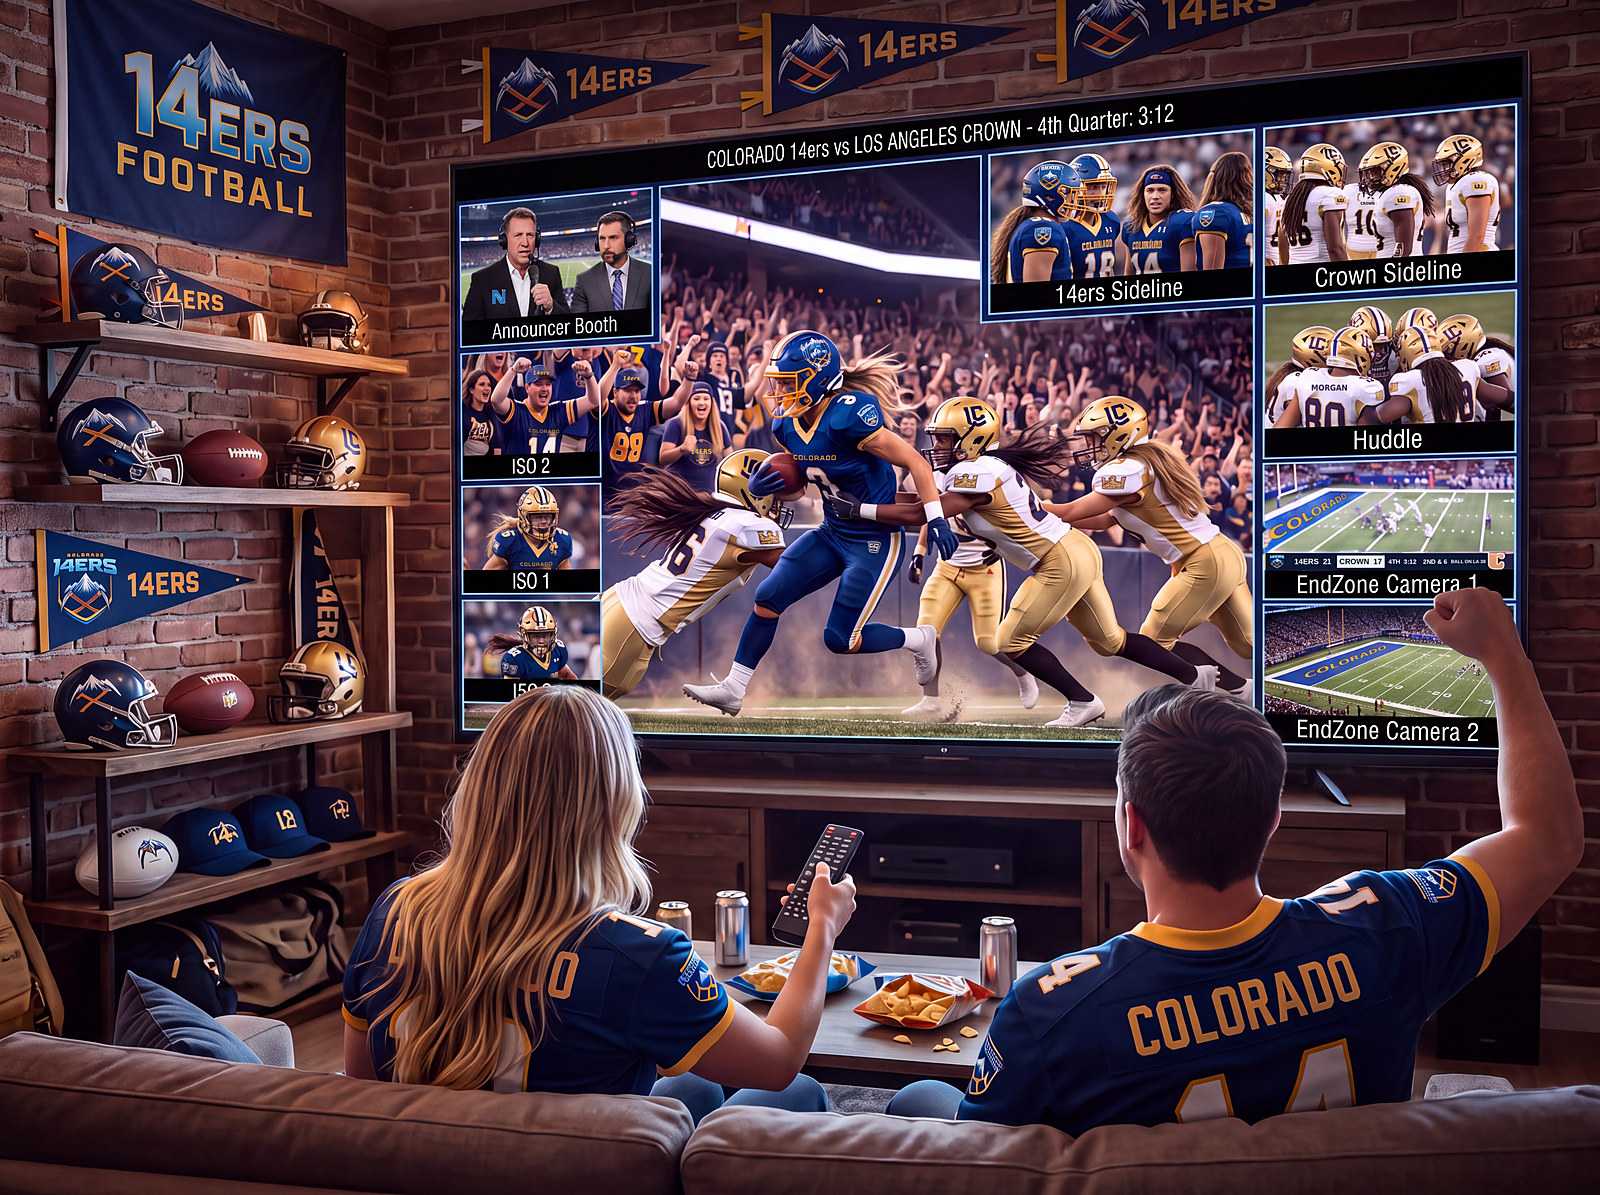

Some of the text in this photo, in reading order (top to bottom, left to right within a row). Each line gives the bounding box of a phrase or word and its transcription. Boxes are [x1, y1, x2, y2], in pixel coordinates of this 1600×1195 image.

[859, 30, 957, 67] 14ERS
[566, 65, 652, 100] 14ERS
[125, 51, 311, 174] 14ERS
[707, 143, 784, 168] COLORADO
[791, 141, 830, 160] 14ers
[834, 142, 850, 156] vs
[854, 133, 883, 154] LOS
[888, 126, 957, 150] ANGELES
[962, 120, 1021, 143] CROWN
[1038, 116, 1062, 136] 4th
[1068, 110, 1134, 133] Quarter:
[1138, 103, 1174, 126] 3:12
[117, 142, 313, 218] FOOTBALL
[1316, 260, 1462, 288] Crown Sideline
[491, 289, 506, 304] N
[1056, 279, 1183, 304] 14ers Sideline
[492, 316, 618, 340] Announcer Booth
[1311, 384, 1348, 392] MORGAN
[1305, 396, 1346, 428] 80
[1354, 428, 1422, 450] Huddle
[512, 457, 550, 474] ISO 2
[1269, 493, 1347, 540] COLORADO
[53, 558, 118, 576] 14ERS
[513, 572, 549, 589] ISO 1
[128, 571, 200, 597] 14ERS
[1298, 574, 1476, 594] EndZone Camera 1
[315, 573, 340, 639] 14ER
[1304, 645, 1387, 678] COLORADO
[1297, 719, 1479, 742] EndZone Camera 2
[1127, 952, 1362, 1057] COLORADO
